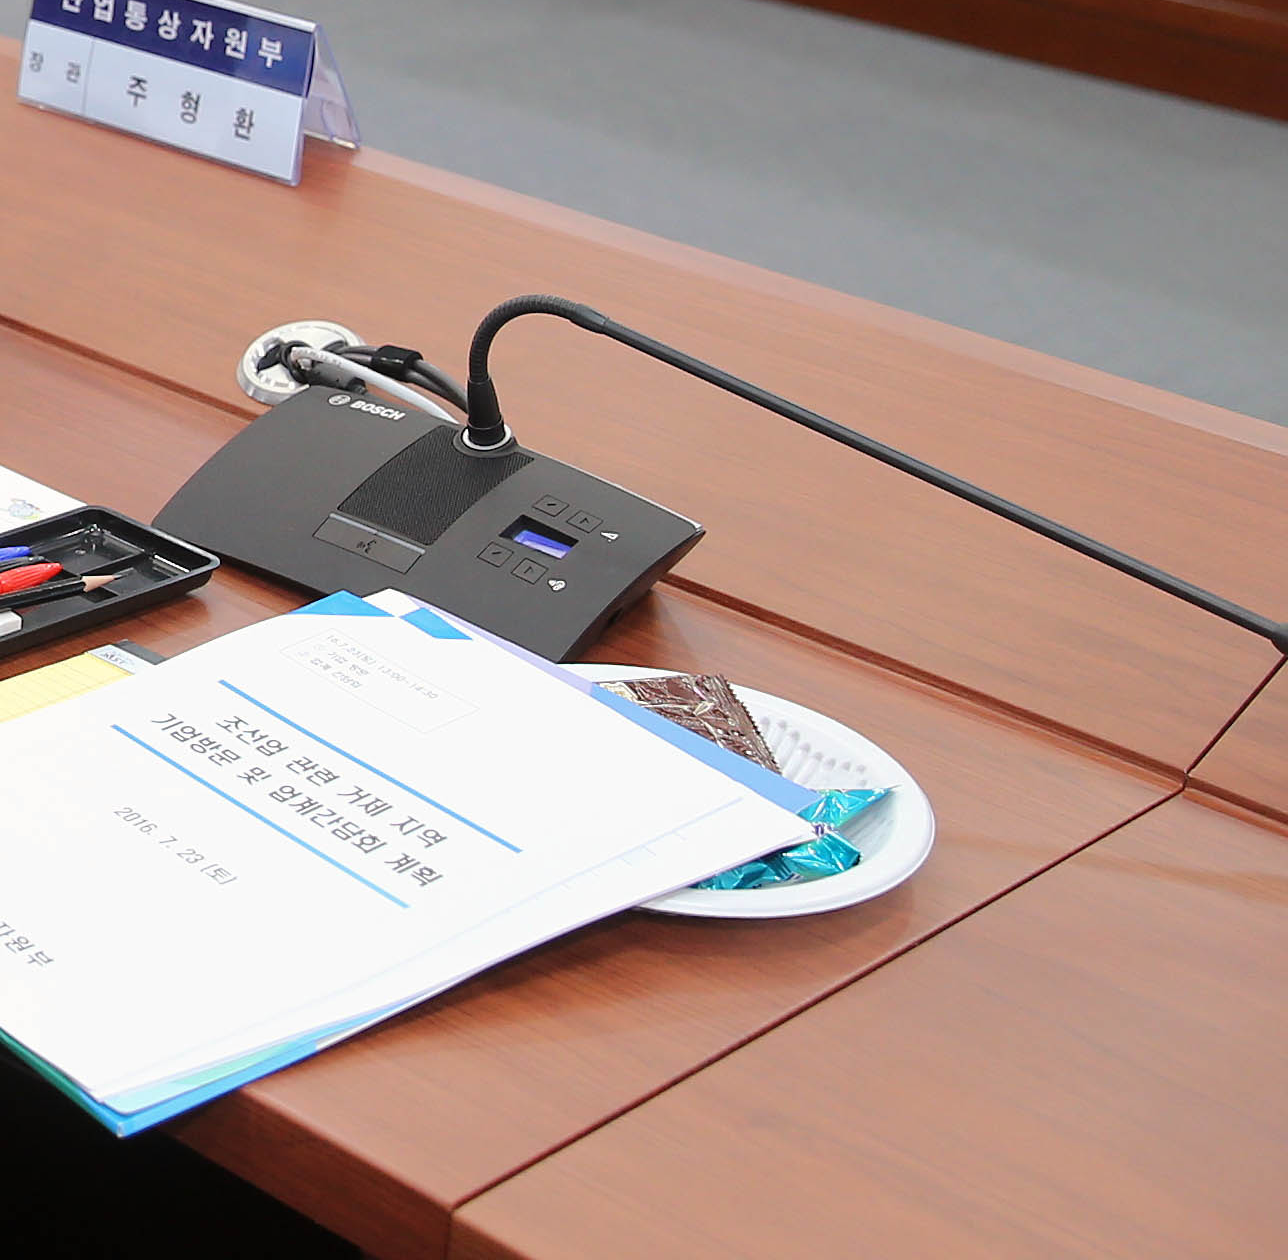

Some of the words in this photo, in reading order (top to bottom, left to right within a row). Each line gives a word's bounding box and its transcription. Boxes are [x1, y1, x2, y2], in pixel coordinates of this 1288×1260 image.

[350, 400, 406, 420] BOSCH
[151, 713, 241, 767] 기업방문
[237, 766, 272, 786] 및
[268, 785, 387, 855] 업계간담회
[383, 852, 445, 888] 계획
[216, 715, 289, 758] 조선업
[285, 755, 340, 787] 관련
[337, 785, 393, 819] 거제
[389, 815, 448, 849] 지역
[113, 806, 159, 836] 2016.
[159, 835, 178, 849] 7.
[176, 847, 205, 865] 23
[200, 863, 239, 886] (토)
